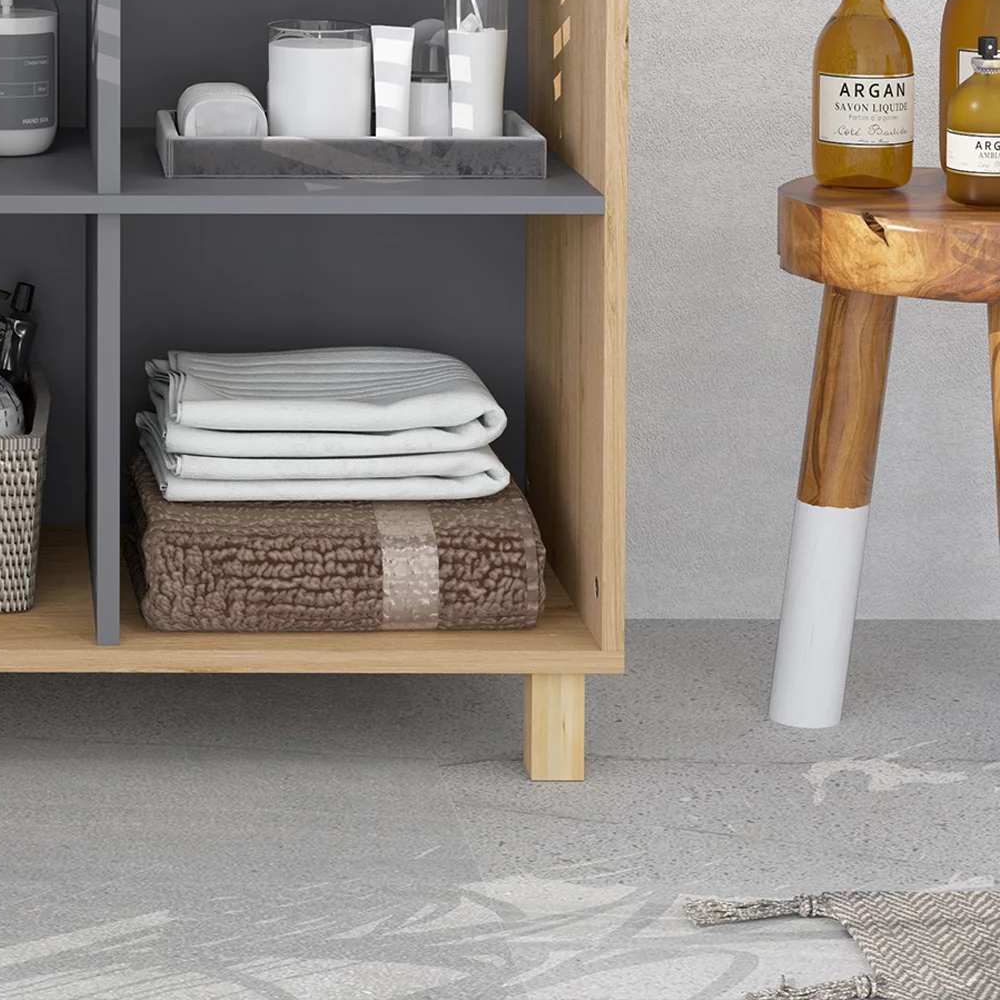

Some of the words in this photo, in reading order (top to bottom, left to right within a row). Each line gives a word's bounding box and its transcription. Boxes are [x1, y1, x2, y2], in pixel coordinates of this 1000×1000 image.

[839, 82, 906, 98] ARGAN
[834, 102, 869, 112] SAVON
[872, 102, 908, 114] LIQUIDE
